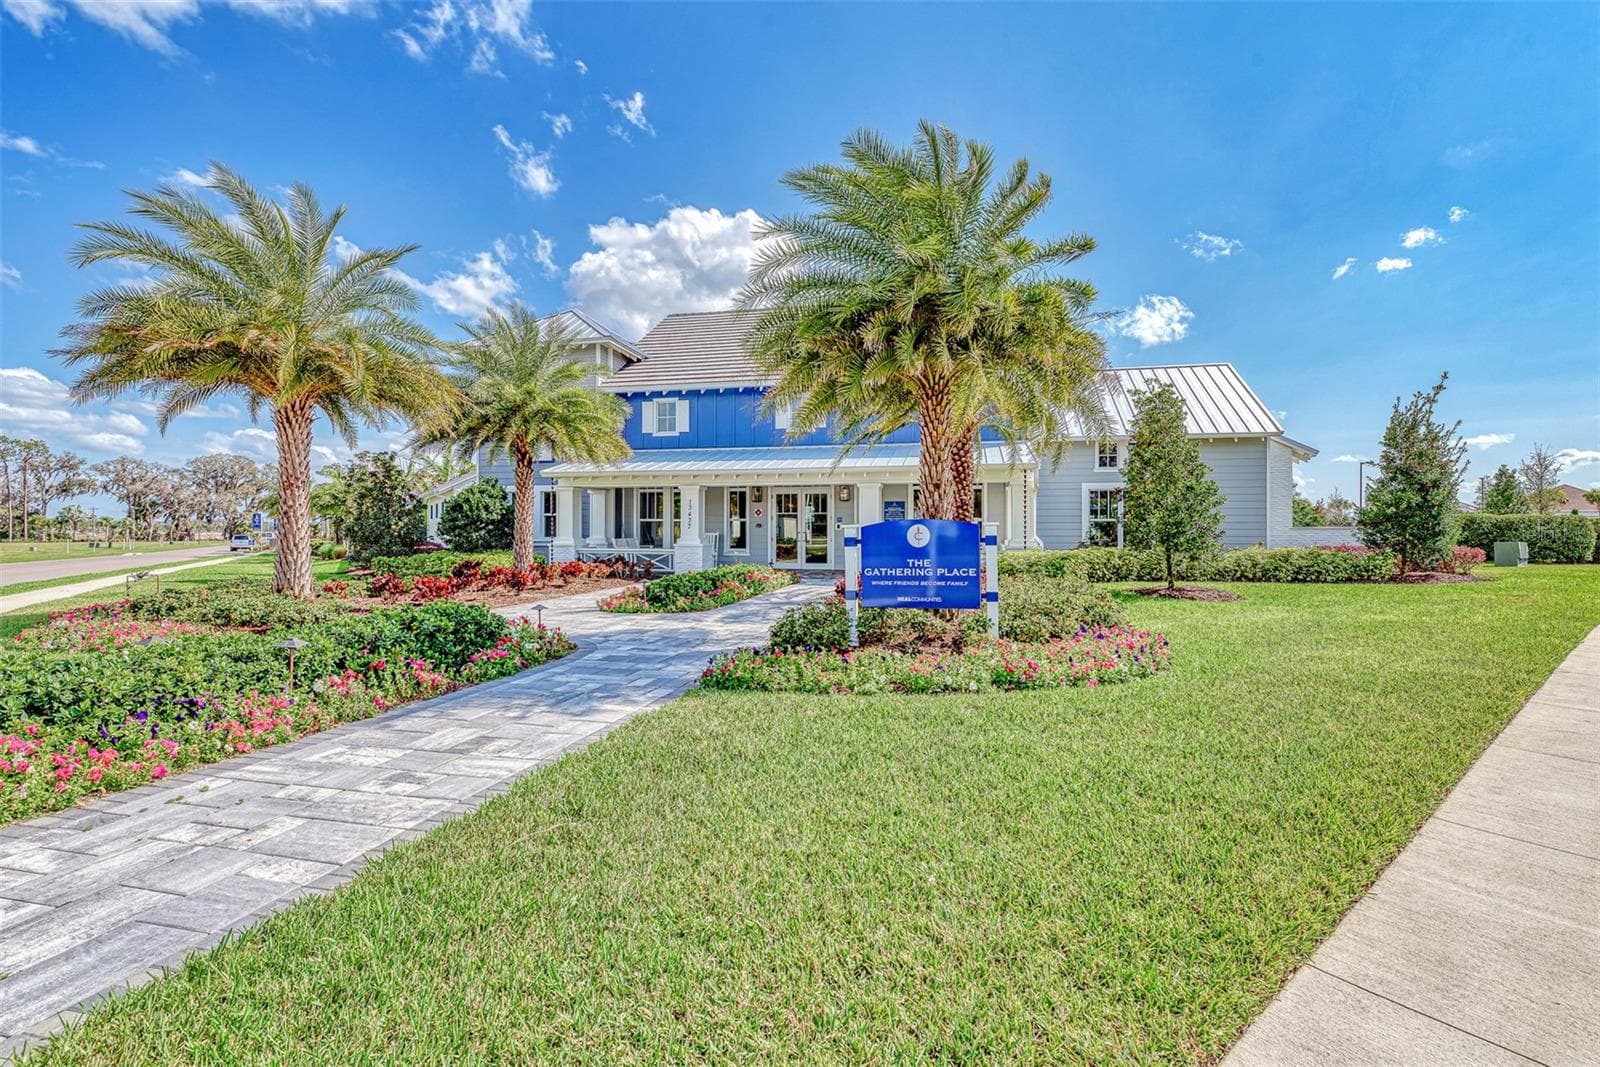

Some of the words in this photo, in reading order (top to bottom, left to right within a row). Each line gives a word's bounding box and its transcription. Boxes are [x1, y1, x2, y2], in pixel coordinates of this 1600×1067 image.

[907, 559, 931, 567] THE
[864, 568, 933, 576] GATHERING
[937, 568, 977, 576] PLACE
